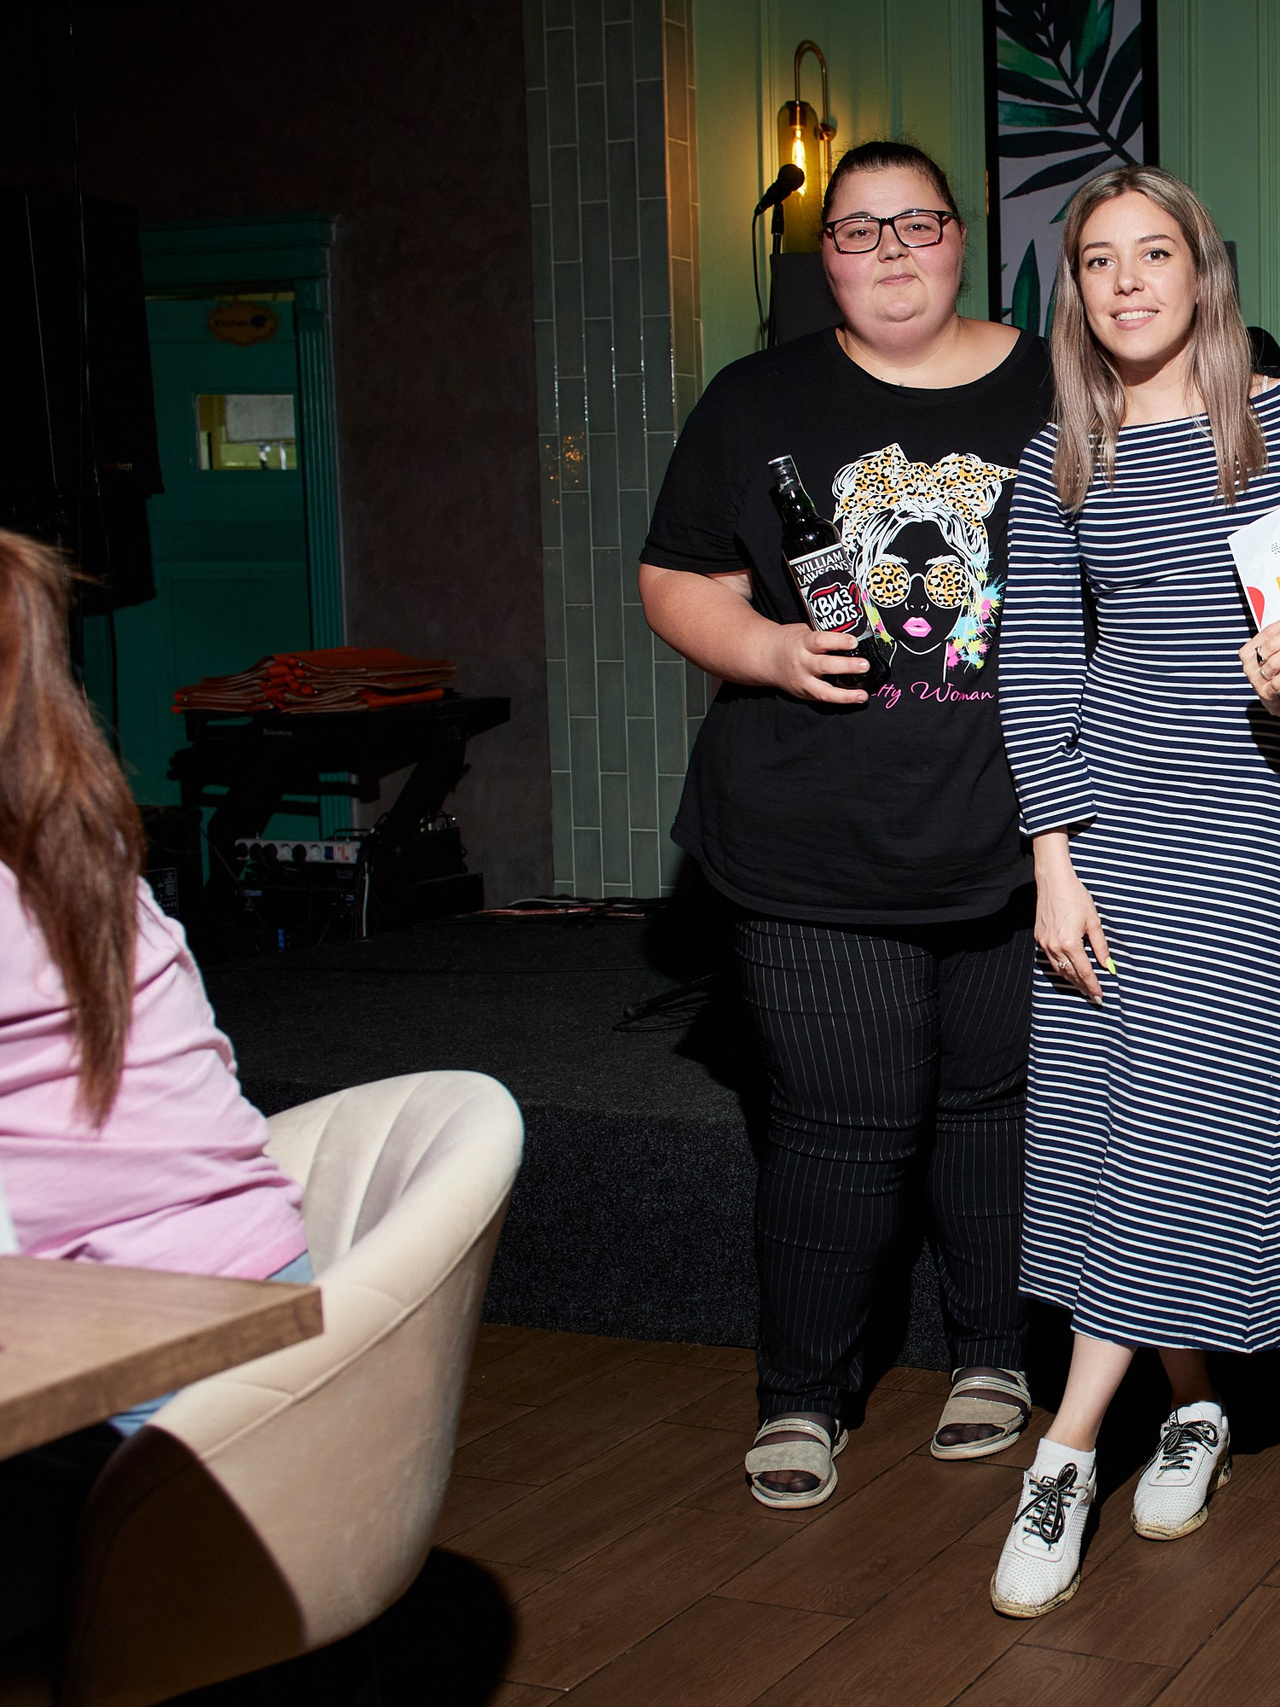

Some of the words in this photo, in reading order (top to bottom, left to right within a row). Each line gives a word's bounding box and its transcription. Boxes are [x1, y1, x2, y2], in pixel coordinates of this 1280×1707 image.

[795, 550, 844, 575] WILLIAM
[815, 604, 858, 630] WHOIS
[871, 683, 902, 710] tty
[910, 680, 995, 704] Woman
